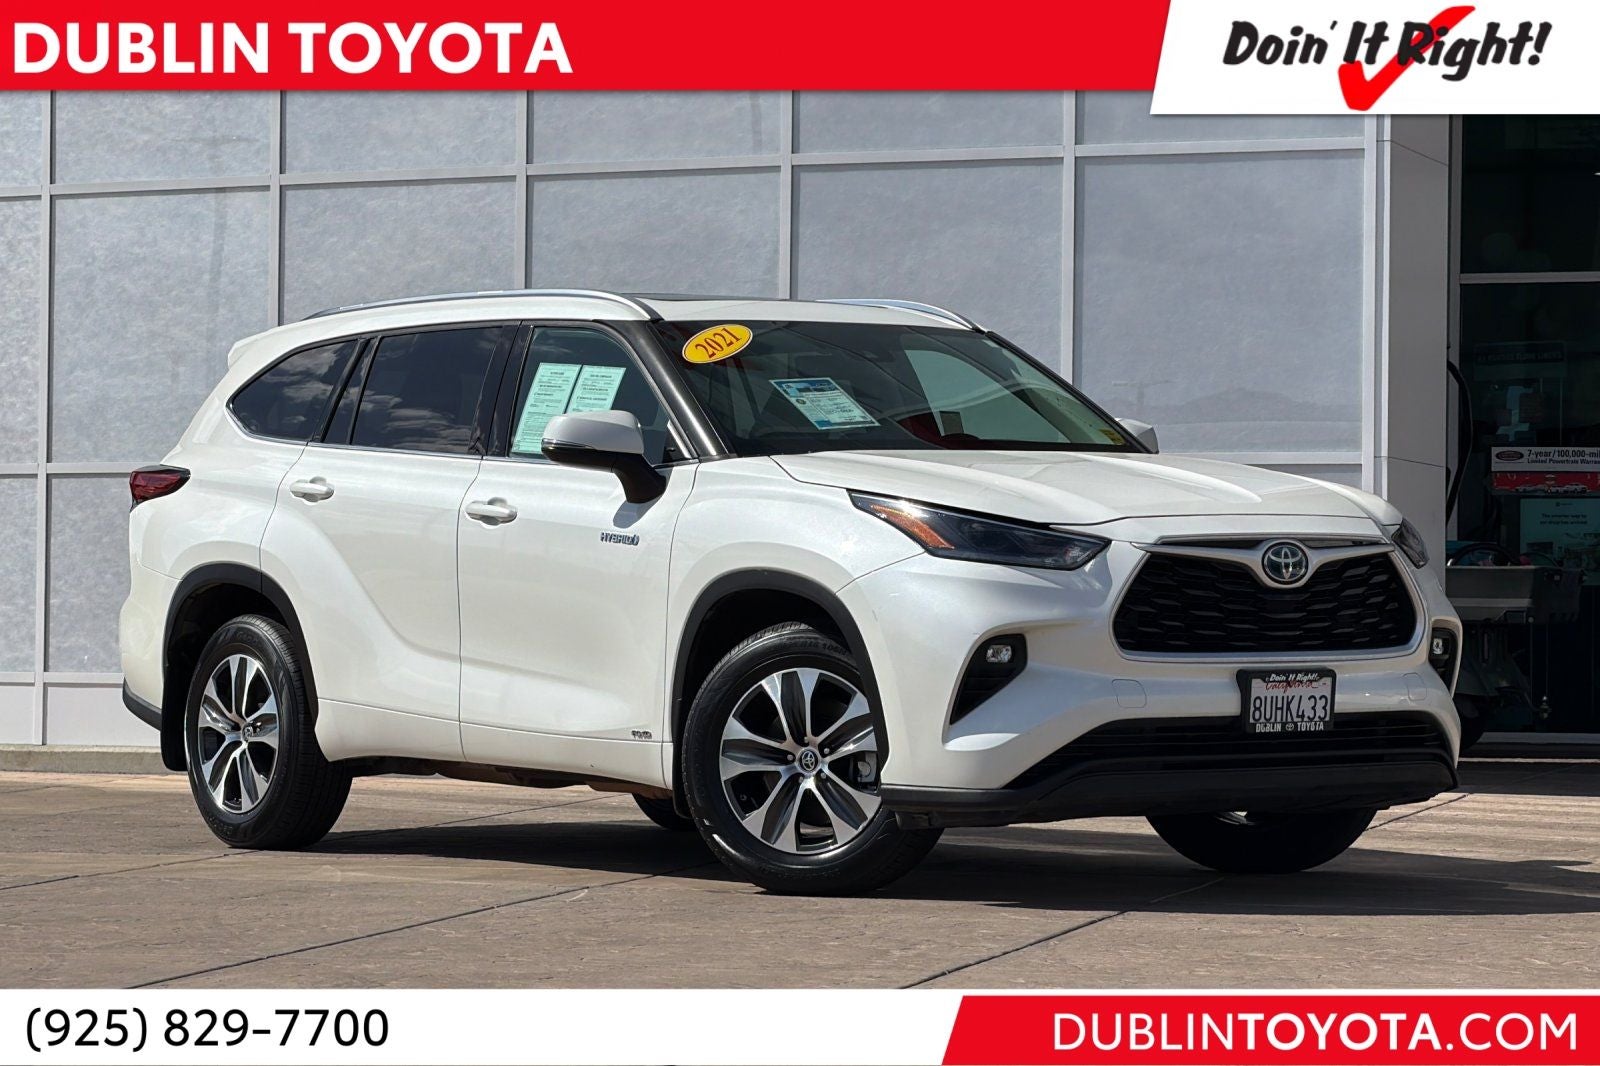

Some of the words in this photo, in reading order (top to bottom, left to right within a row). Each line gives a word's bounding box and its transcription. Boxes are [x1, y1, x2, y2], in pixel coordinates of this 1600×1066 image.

[694, 326, 742, 360] 2021
[1252, 694, 1329, 722] 8UHK433
[1255, 722, 1282, 733] DUBLIN
[1297, 721, 1324, 732] TOYOTA
